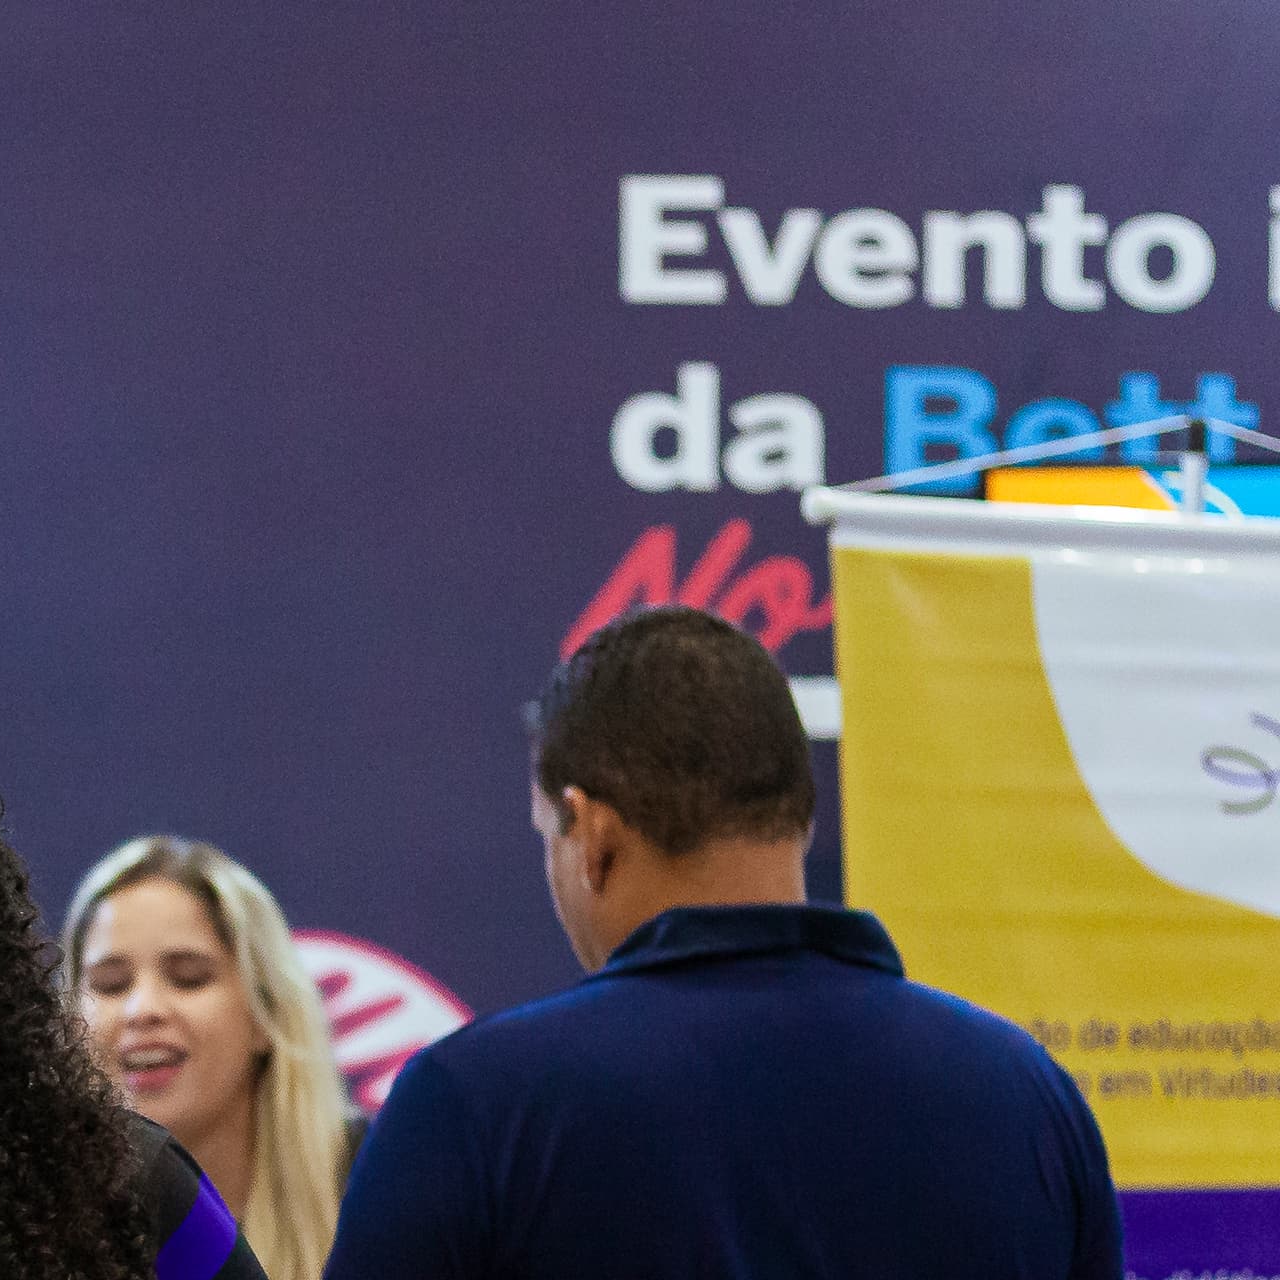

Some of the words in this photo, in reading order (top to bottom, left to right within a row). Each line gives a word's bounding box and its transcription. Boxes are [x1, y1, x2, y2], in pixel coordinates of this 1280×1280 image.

[618, 174, 1217, 312] Evento
[610, 361, 827, 493] da
[883, 364, 1262, 494] Bett
[1078, 1017, 1118, 1050] de
